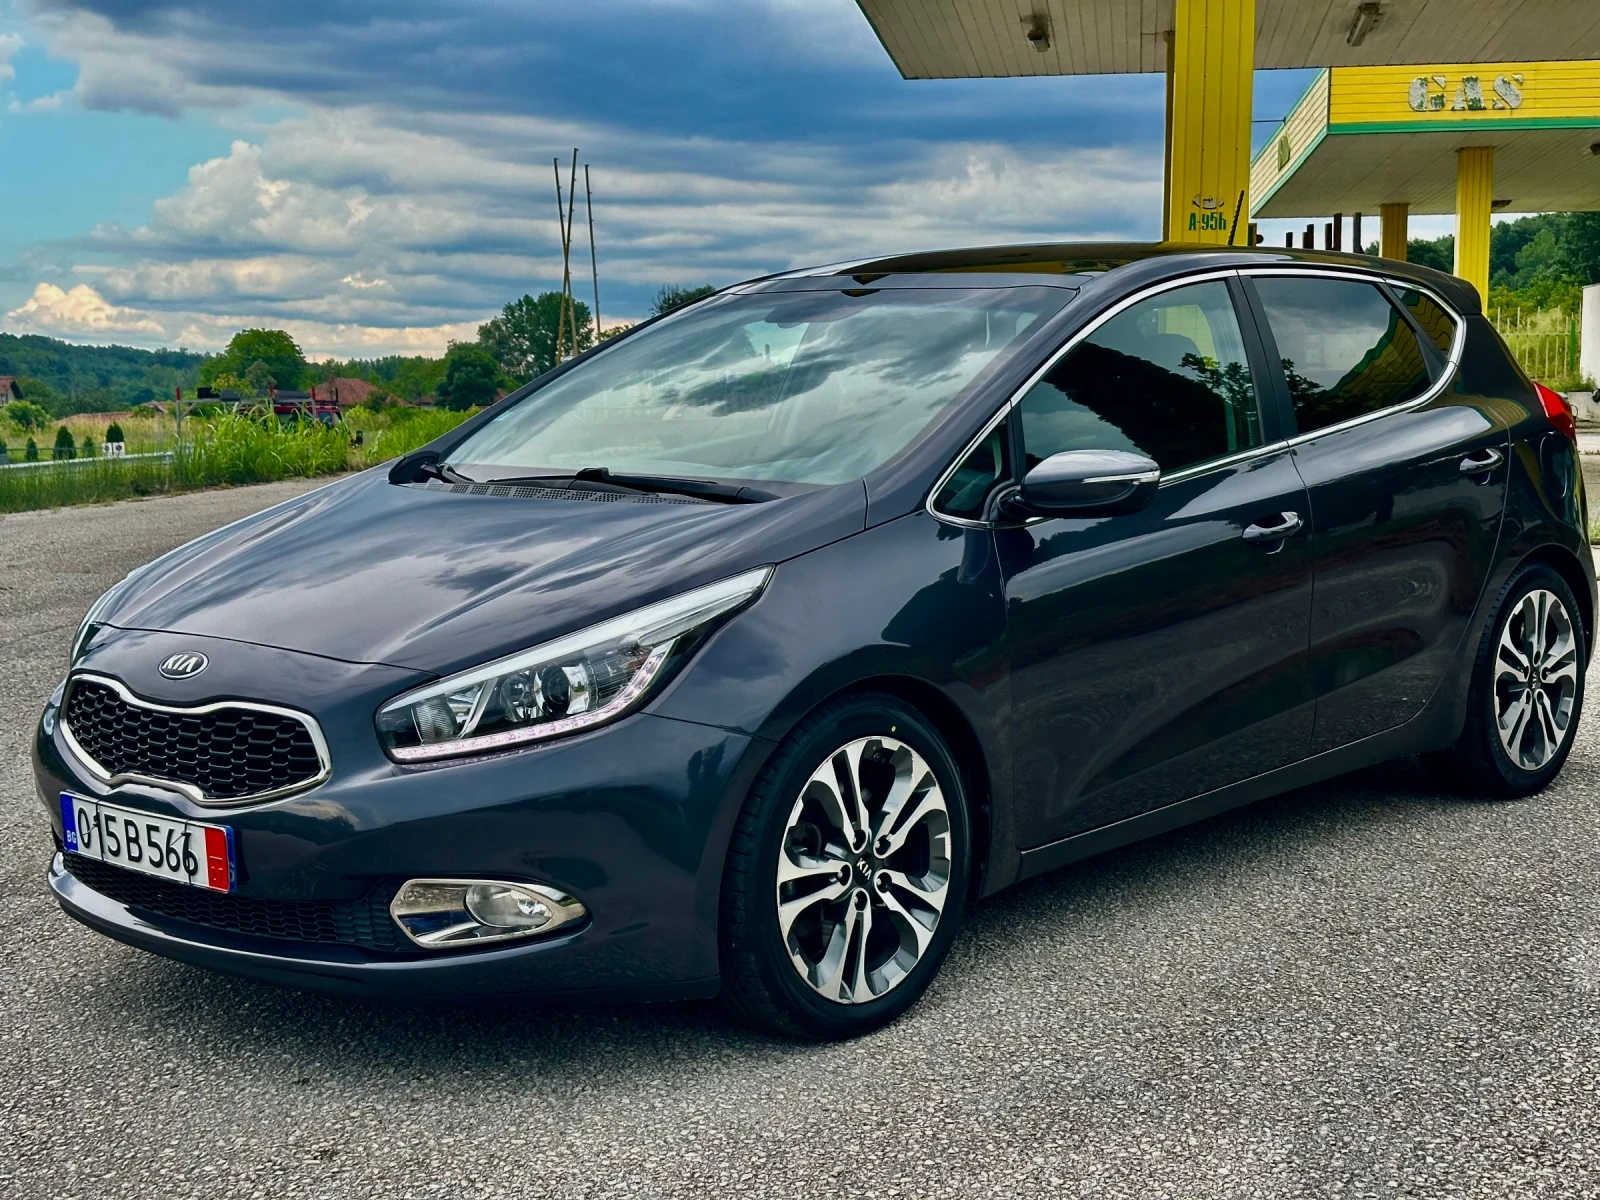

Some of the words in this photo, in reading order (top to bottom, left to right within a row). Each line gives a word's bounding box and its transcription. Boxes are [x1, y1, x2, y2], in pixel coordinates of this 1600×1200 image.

[1408, 74, 1523, 112] GAS
[162, 654, 199, 673] KIA
[66, 829, 77, 844] BG
[856, 857, 872, 881] KIA
